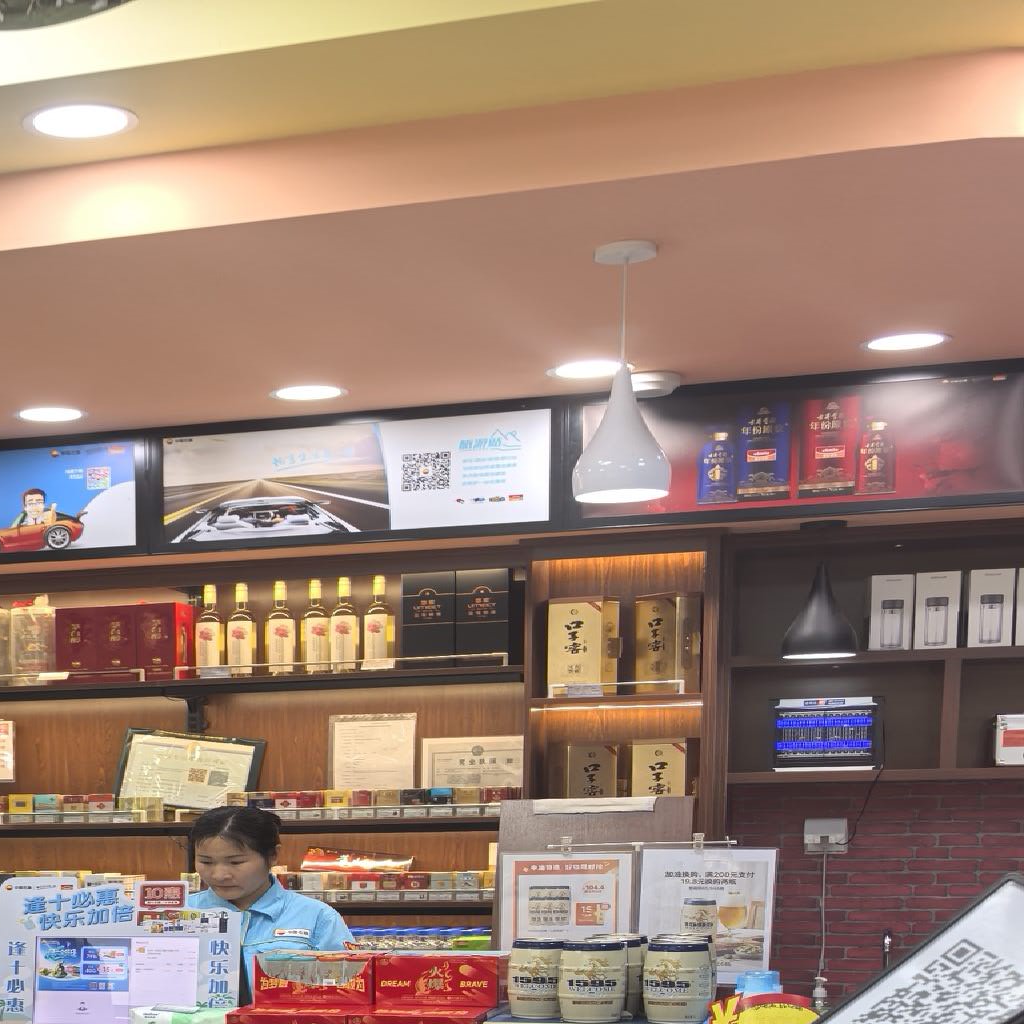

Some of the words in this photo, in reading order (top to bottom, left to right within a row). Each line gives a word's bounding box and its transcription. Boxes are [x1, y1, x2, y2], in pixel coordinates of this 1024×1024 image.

[564, 620, 584, 654] 口子窖
[24, 888, 119, 914] 逢十必惠
[39, 905, 134, 931] 快乐加倍
[381, 980, 411, 988] DREAM
[460, 980, 489, 988] BRAVE
[567, 979, 617, 987] 1595
